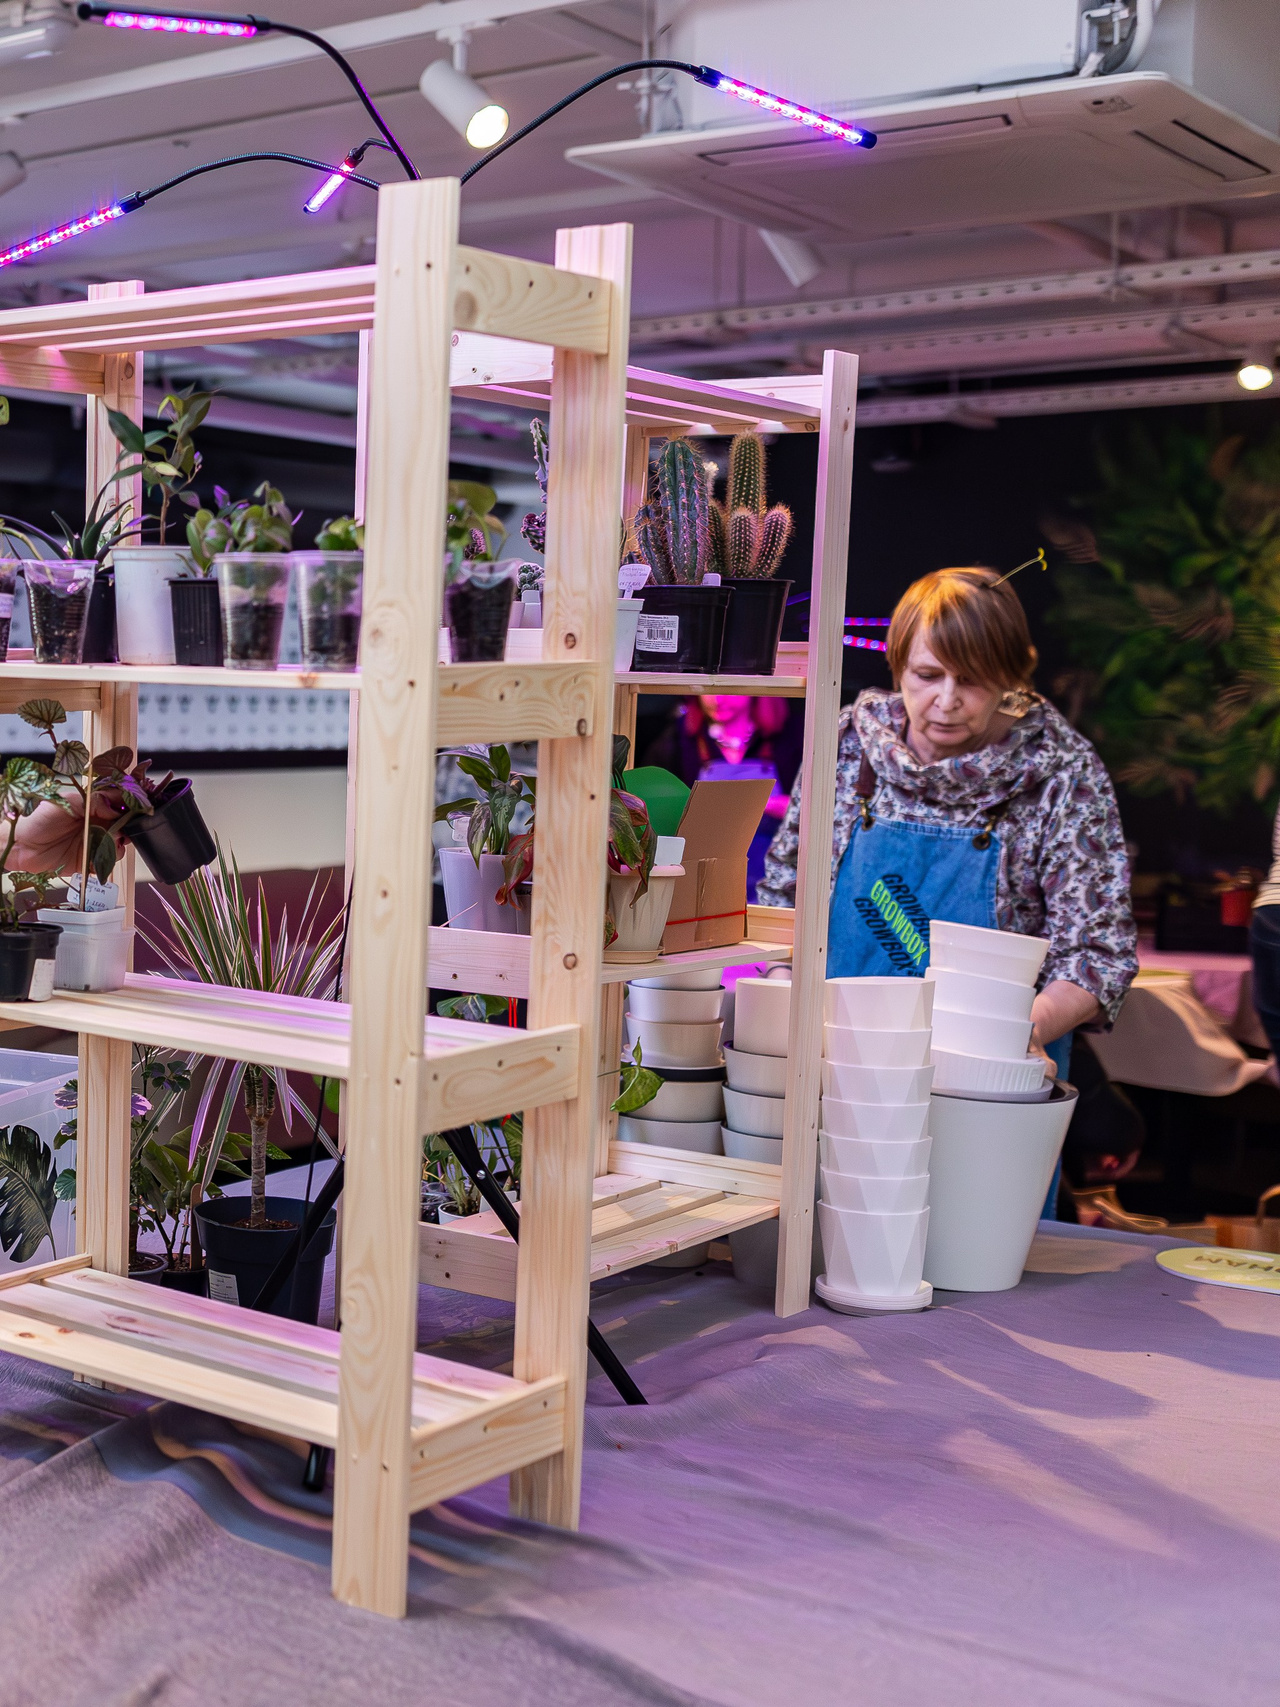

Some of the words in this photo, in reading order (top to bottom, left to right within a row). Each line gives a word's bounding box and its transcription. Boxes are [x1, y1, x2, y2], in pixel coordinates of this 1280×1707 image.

[854, 897, 918, 971] GROWBOX
[871, 879, 927, 966] GROWBOX
[882, 874, 930, 949] GROWBO
